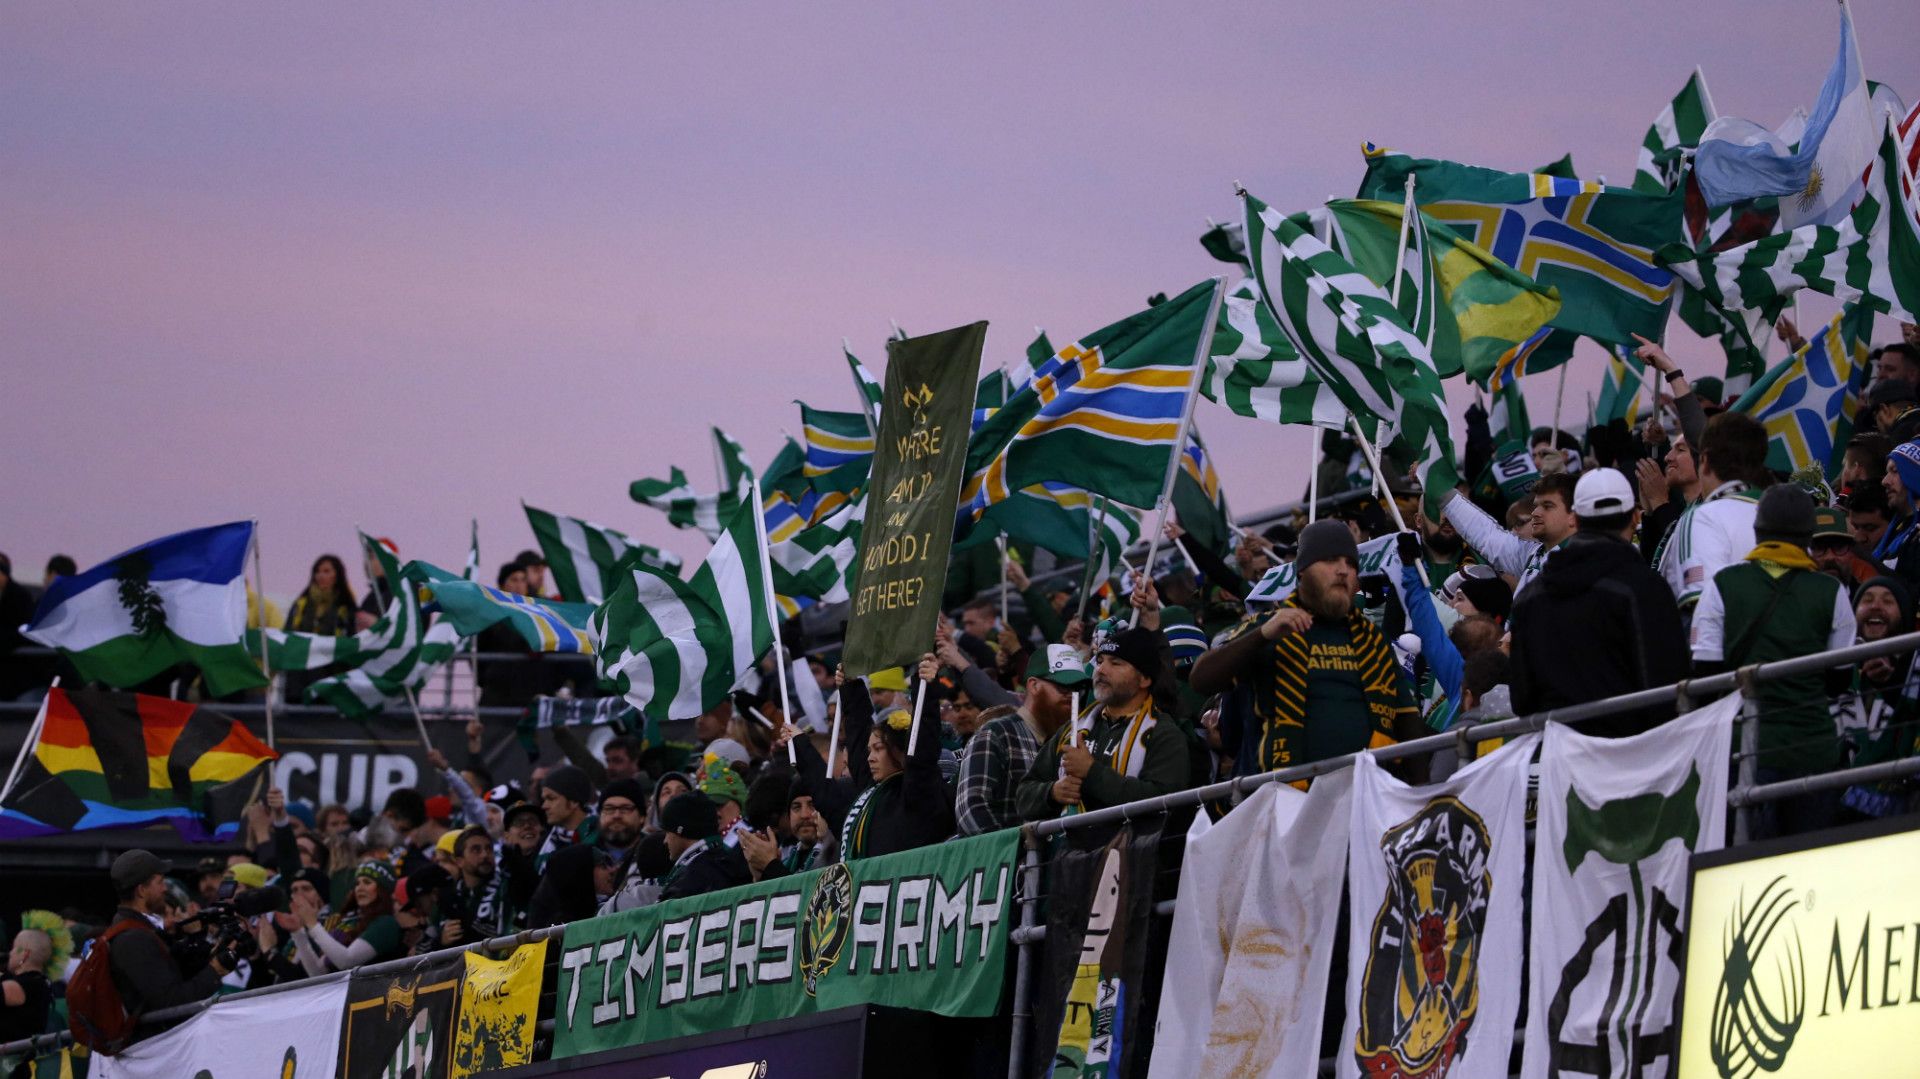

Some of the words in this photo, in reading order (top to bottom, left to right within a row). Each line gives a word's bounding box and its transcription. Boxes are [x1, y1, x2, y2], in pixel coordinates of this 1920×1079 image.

[886, 476, 914, 503] AM
[886, 535, 917, 566] DID
[920, 532, 931, 561] I
[857, 585, 877, 616] GET
[876, 577, 924, 612] HERE?
[1308, 656, 1360, 670] Airlin
[1310, 643, 1355, 656] Alask
[274, 751, 419, 818] CUP
[561, 888, 802, 1033] TIMBERS
[847, 862, 1010, 975] ARMY
